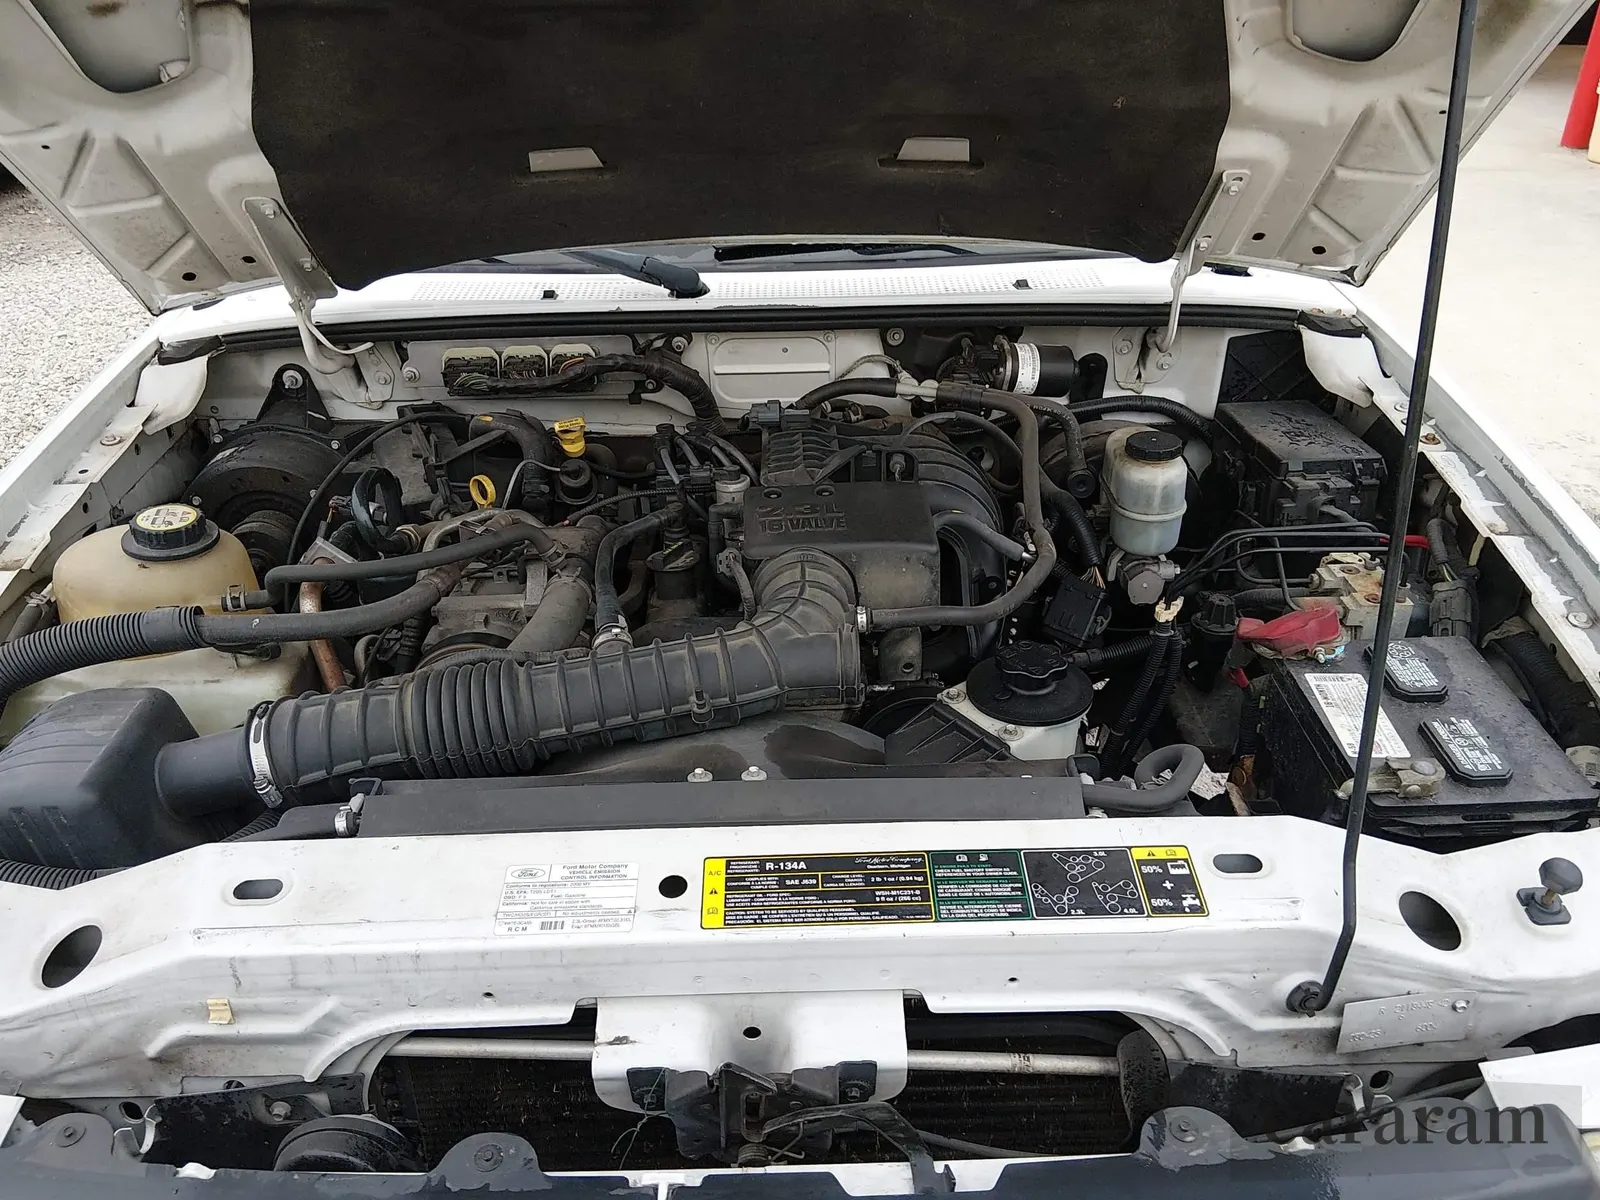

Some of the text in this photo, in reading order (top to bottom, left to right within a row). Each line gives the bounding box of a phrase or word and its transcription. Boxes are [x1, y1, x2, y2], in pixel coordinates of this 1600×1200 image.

[758, 516, 848, 534] 16 VALVE
[598, 863, 629, 871] Company
[765, 861, 807, 871] R-134A
[1141, 865, 1163, 874] 50%
[518, 869, 539, 878] Ford
[1150, 898, 1174, 907] 50%
